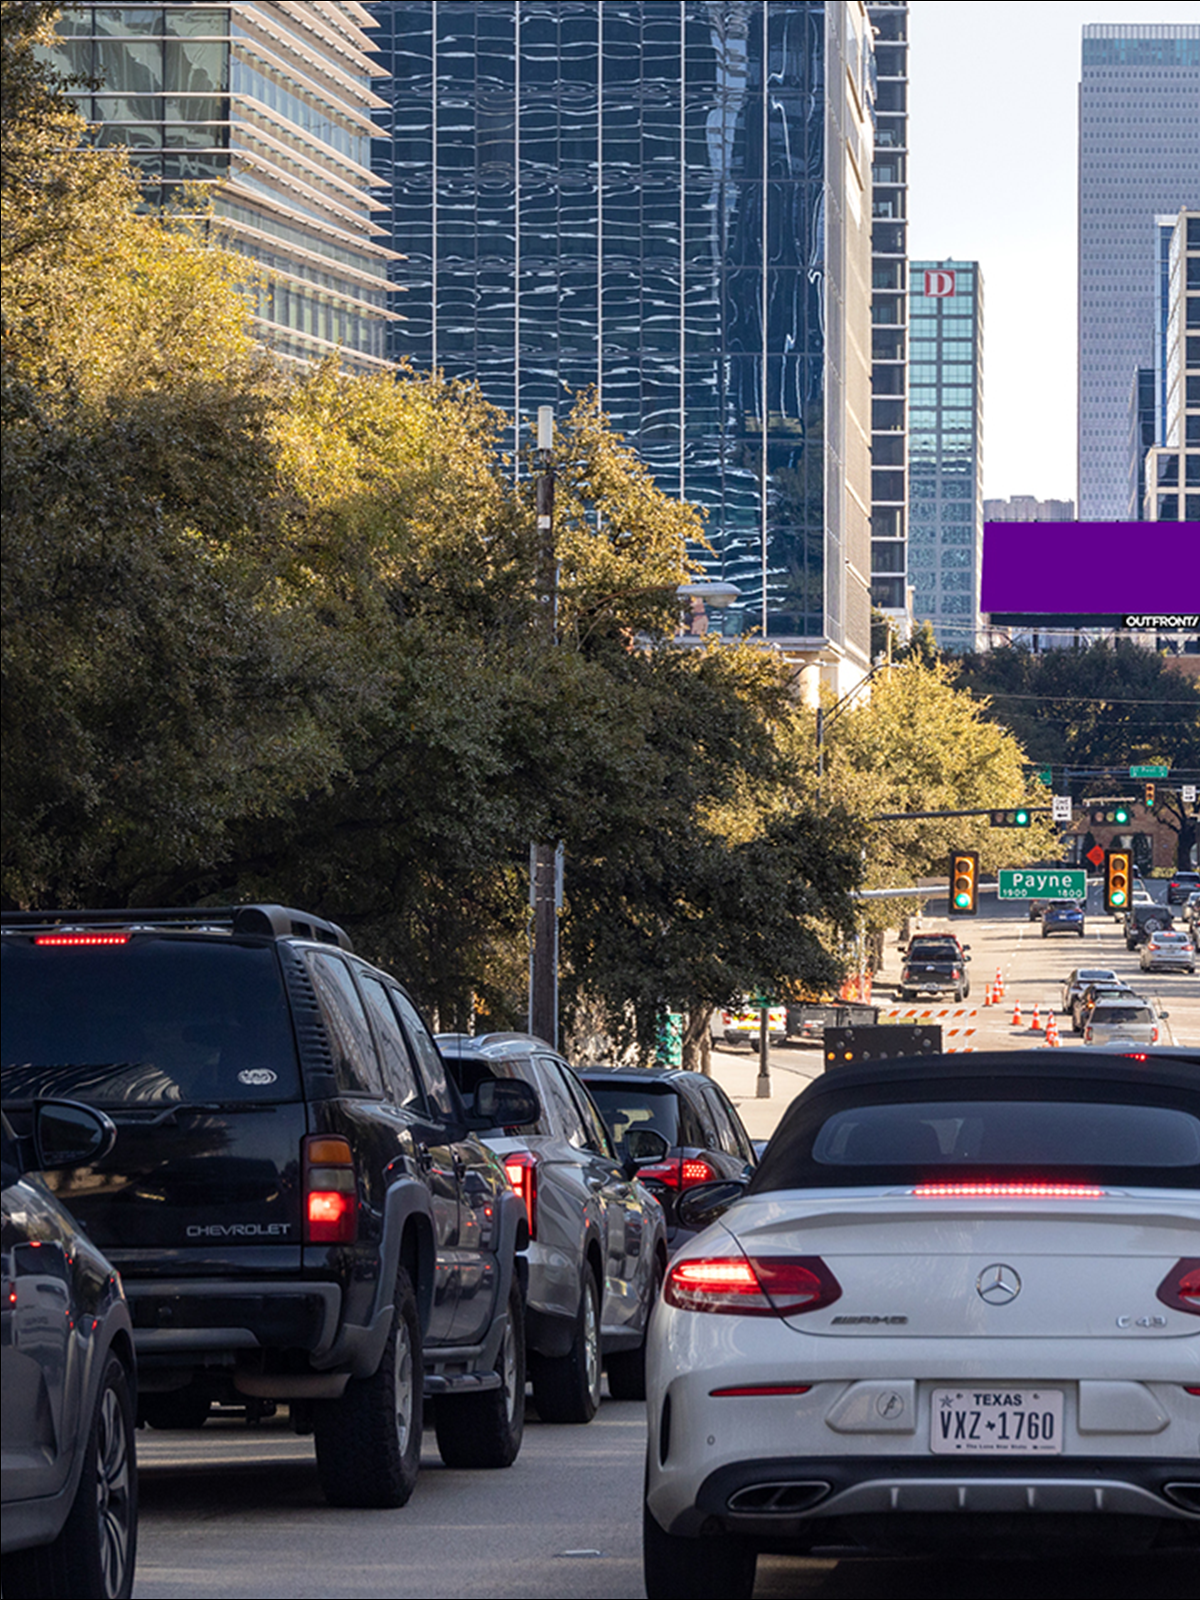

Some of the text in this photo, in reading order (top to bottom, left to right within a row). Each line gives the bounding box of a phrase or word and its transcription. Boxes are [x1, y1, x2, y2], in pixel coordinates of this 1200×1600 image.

[928, 272, 953, 295] D
[1013, 873, 1072, 891] Payne
[1003, 889, 1083, 897] 1900 1800
[186, 1223, 291, 1237] CHEVROLET
[973, 1393, 1022, 1406] TEXAS
